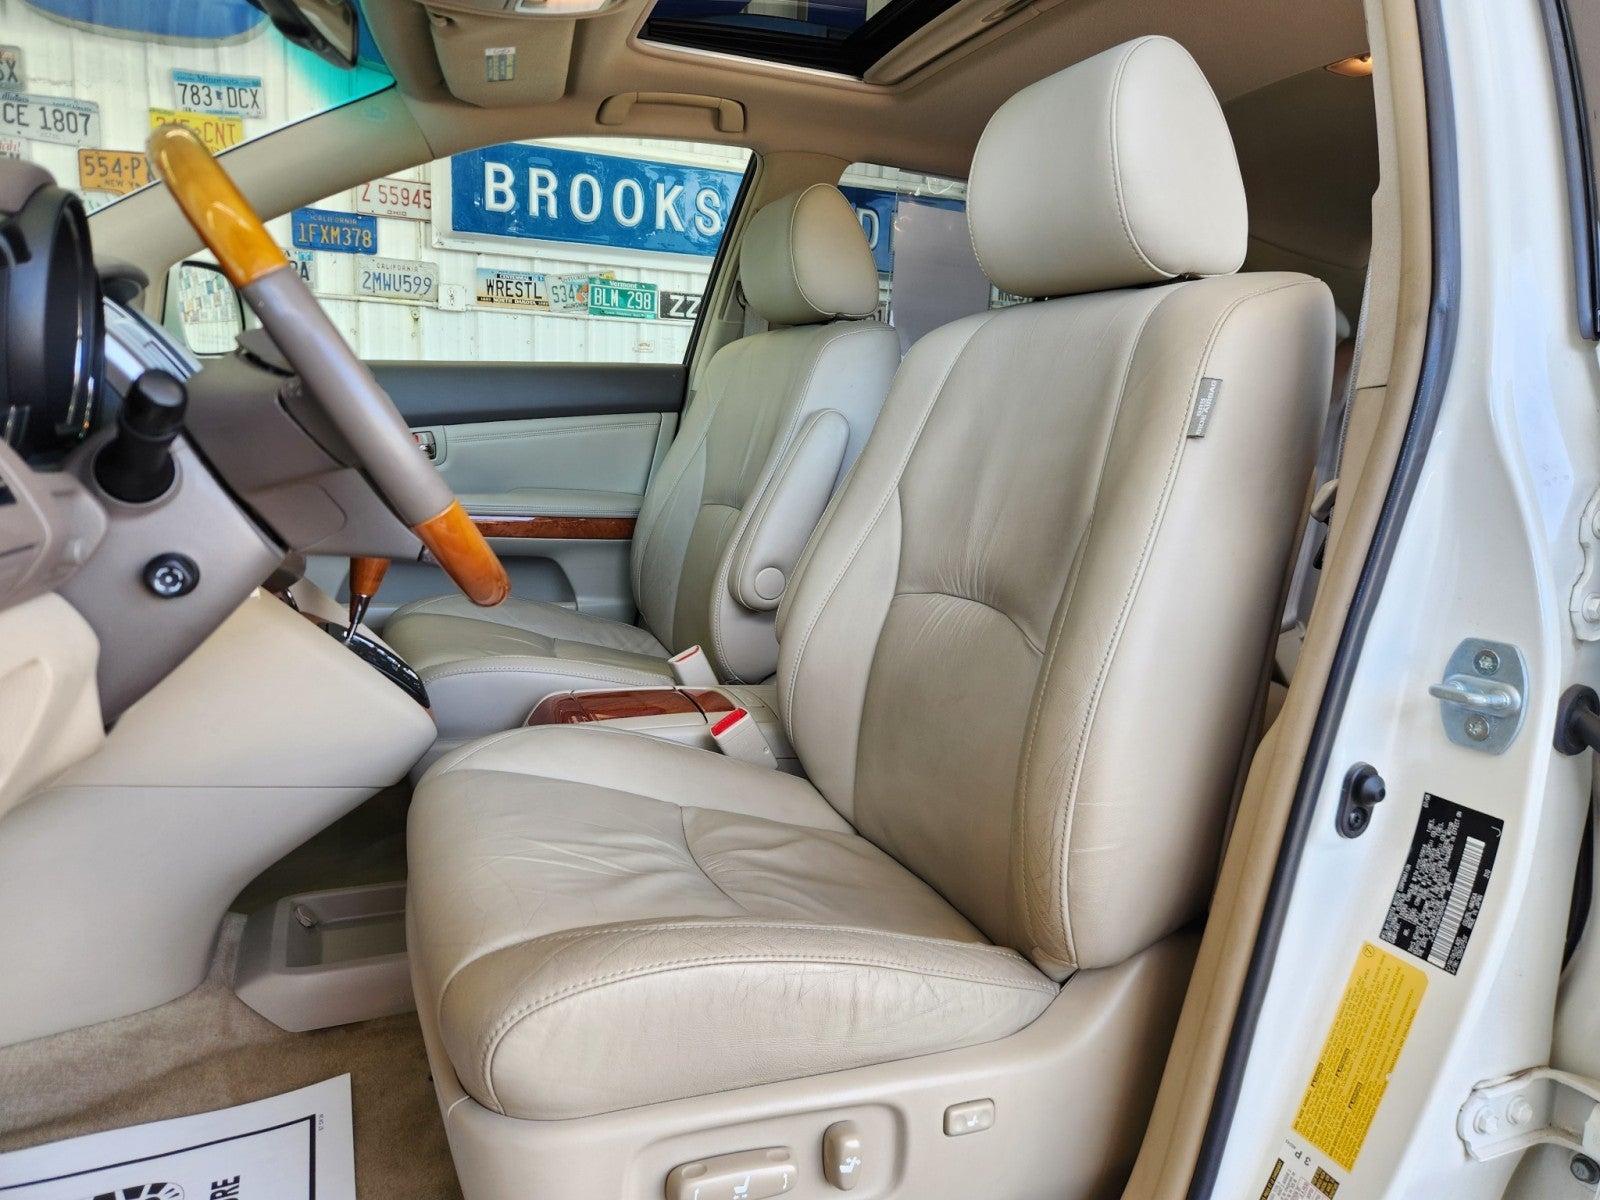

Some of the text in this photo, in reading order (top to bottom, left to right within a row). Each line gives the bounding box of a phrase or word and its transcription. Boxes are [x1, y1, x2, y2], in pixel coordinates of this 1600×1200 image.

[177, 83, 260, 109] 783 DCX
[39, 106, 91, 136] 1807
[362, 182, 431, 210] Z 55945
[484, 162, 722, 237] BROOKS
[313, 214, 357, 224] CALIFORNIA
[298, 222, 372, 248] 1FXM378
[376, 264, 418, 272] CALIFORNIA
[362, 270, 432, 295] 2MWU599
[486, 279, 542, 300] WRESTL
[610, 280, 638, 289] Vermont
[594, 287, 652, 310] BLM 298
